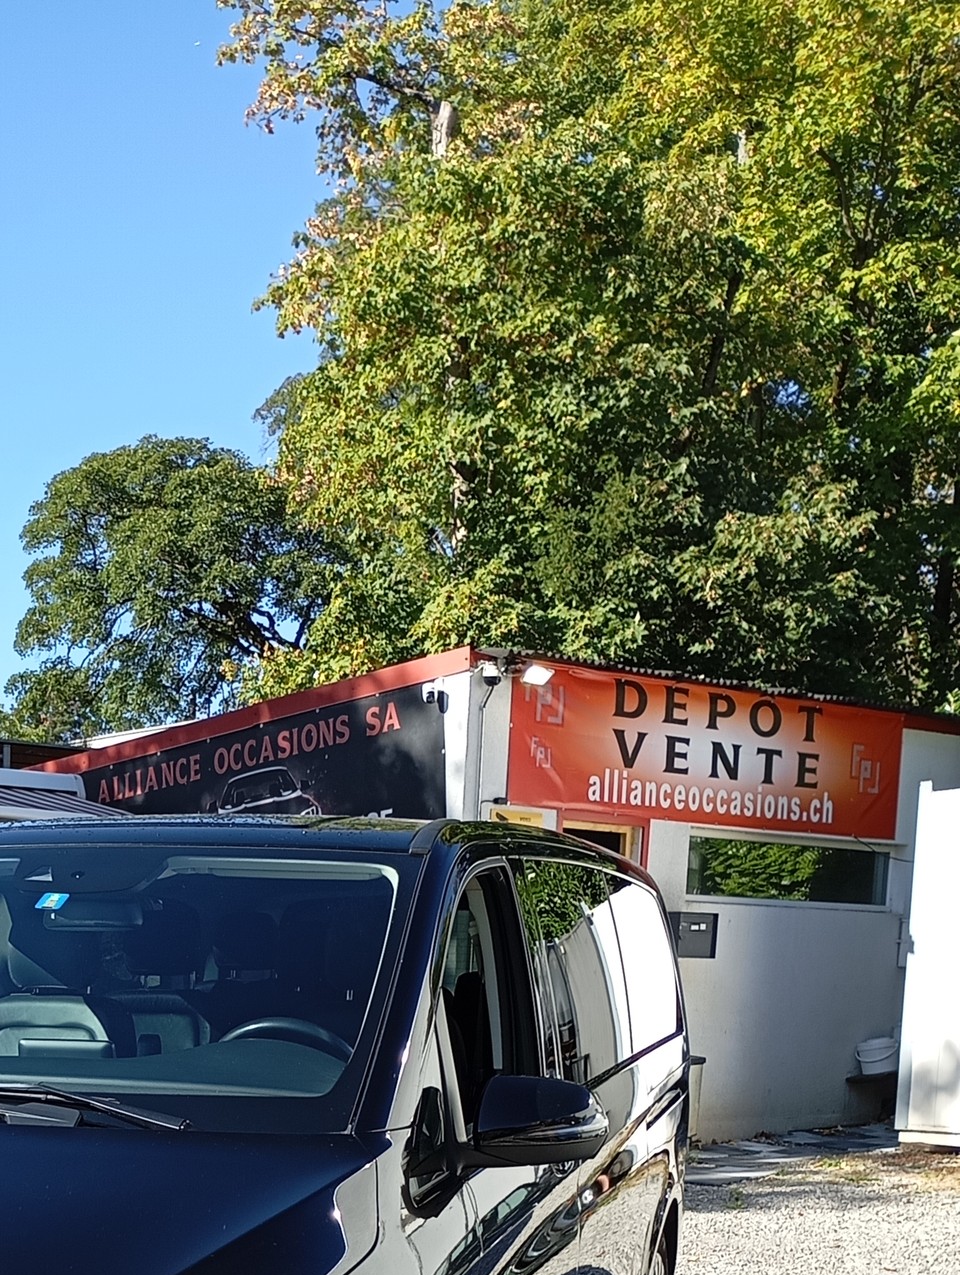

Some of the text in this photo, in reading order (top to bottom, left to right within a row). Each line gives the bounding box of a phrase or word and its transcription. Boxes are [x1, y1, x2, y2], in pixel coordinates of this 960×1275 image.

[98, 702, 401, 803] ALLIANCE OCCASIONS SA
[612, 728, 820, 789] VENTE
[587, 768, 833, 823] allianceoccasions.ch
